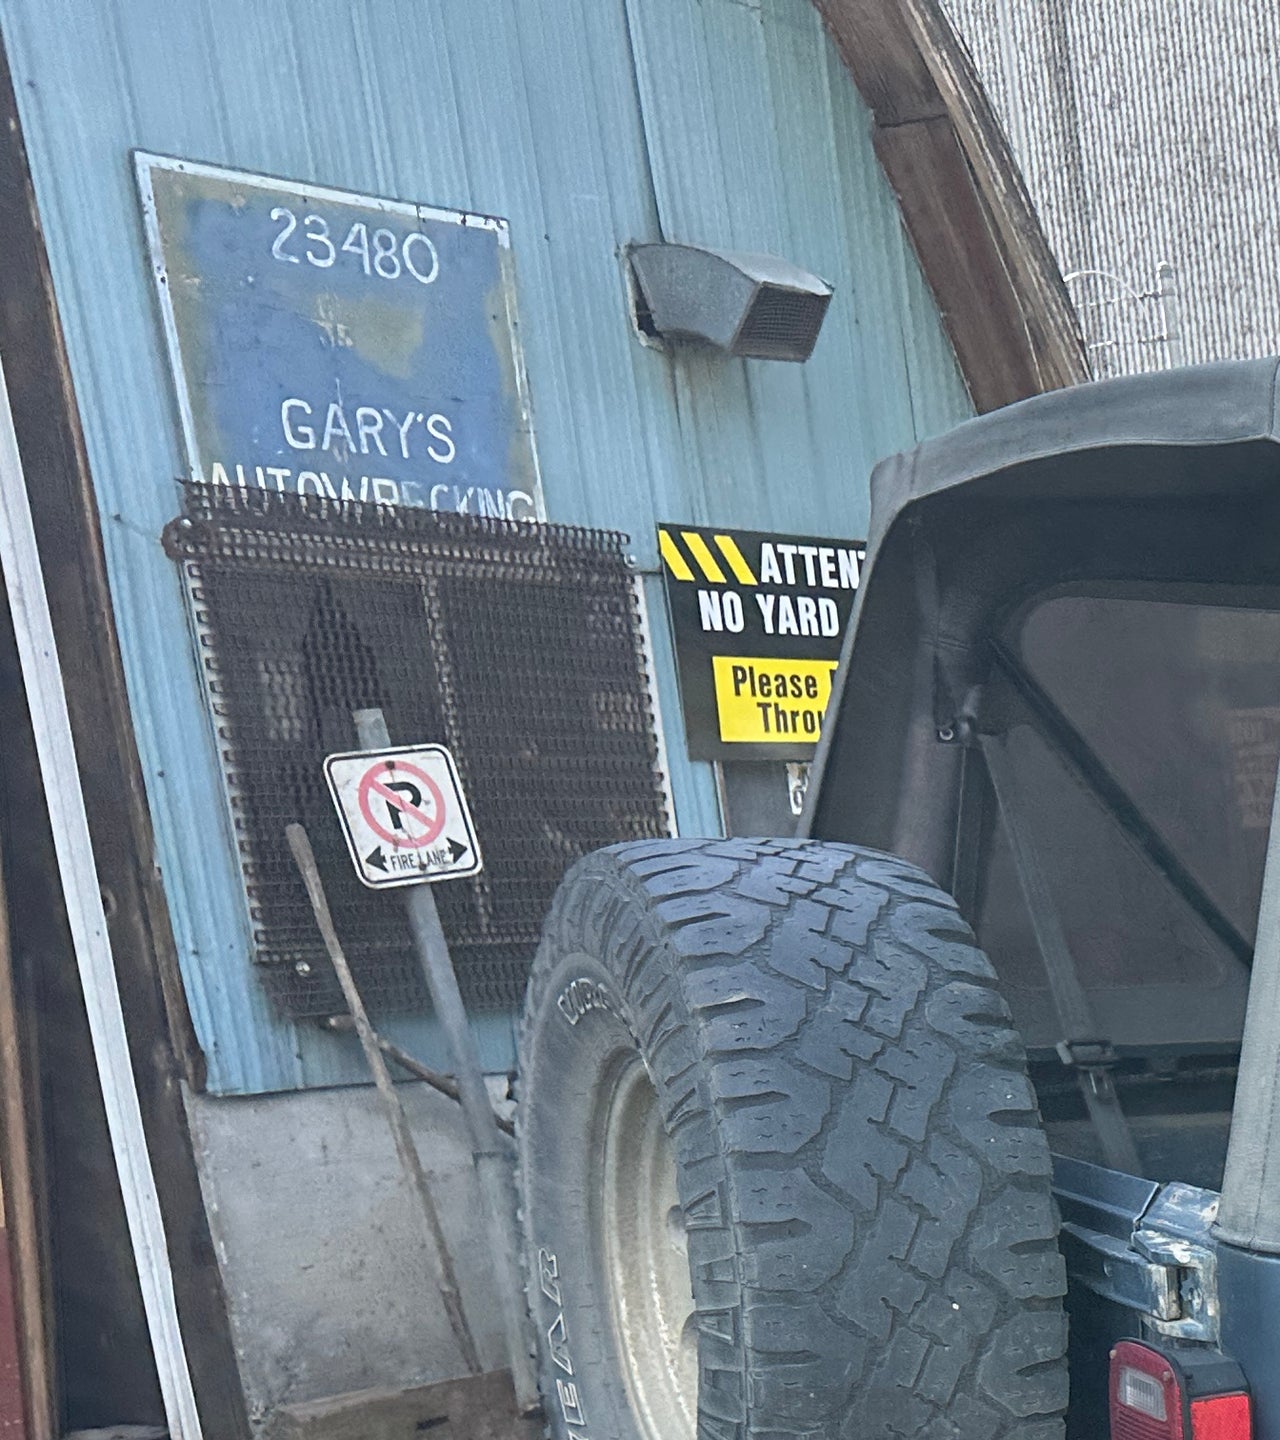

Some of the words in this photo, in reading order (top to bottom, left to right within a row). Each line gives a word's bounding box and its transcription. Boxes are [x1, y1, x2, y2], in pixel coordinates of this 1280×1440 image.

[270, 207, 439, 283] 23480
[281, 398, 456, 464] GARY'S
[760, 542, 866, 589] ATTEN
[698, 580, 745, 633] NO
[756, 594, 840, 637] YARD
[732, 665, 818, 699] Please
[757, 702, 826, 734] Thro
[390, 854, 418, 871] FIRE
[418, 849, 450, 869] LANE
